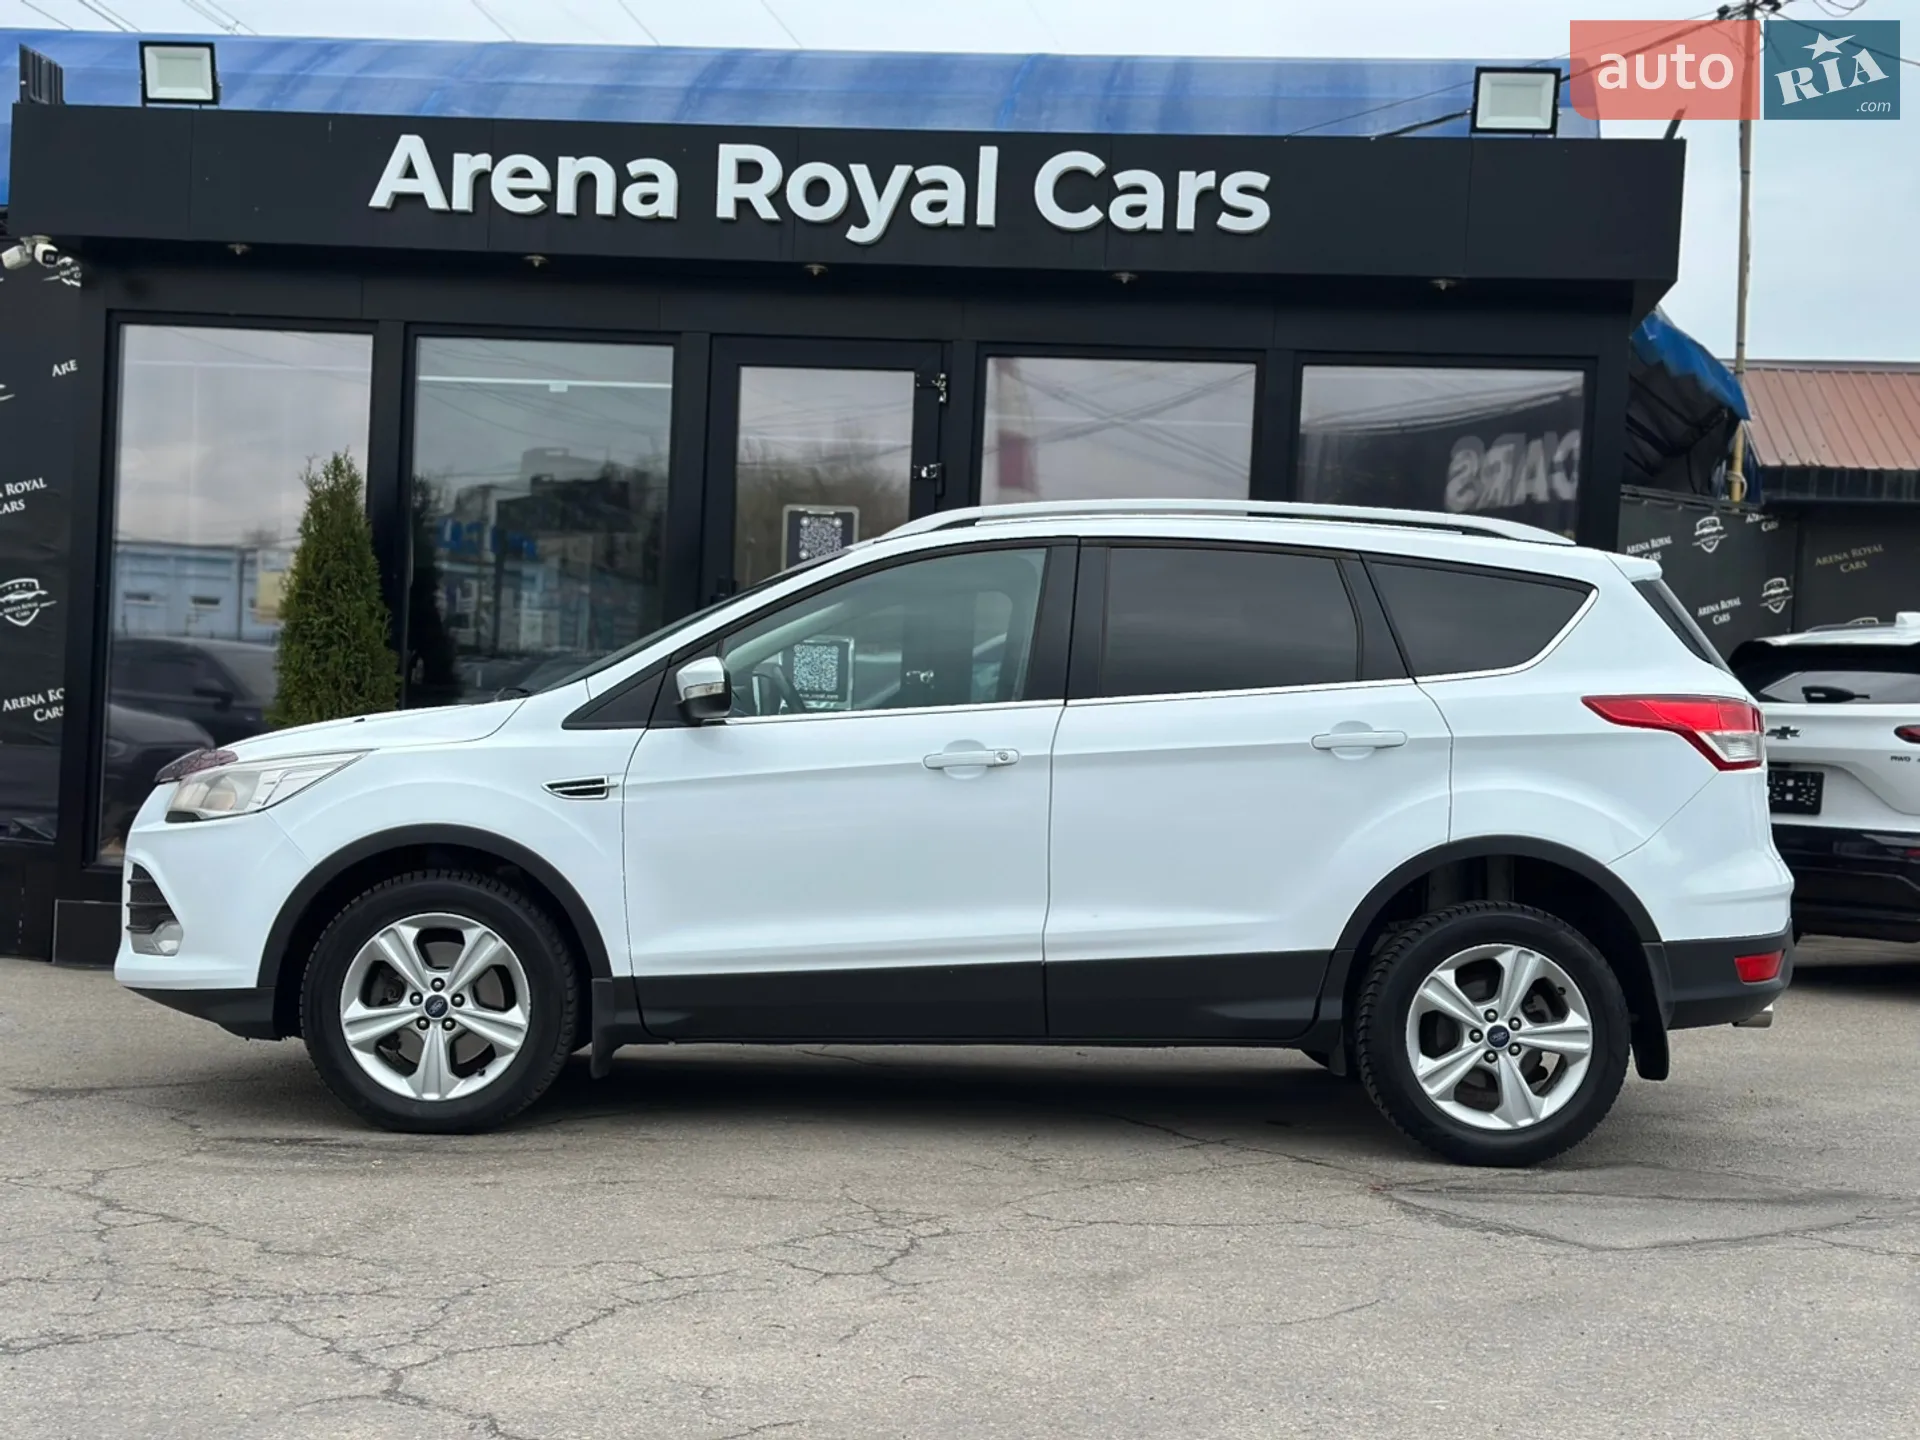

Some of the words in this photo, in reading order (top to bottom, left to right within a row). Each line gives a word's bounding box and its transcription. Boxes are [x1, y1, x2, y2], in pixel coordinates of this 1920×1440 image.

[369, 134, 678, 221] Arena
[715, 143, 999, 246] Royal
[1033, 151, 1273, 233] Cars
[4, 477, 47, 496] ROYAL
[0, 499, 26, 514] ARS
[2, 693, 46, 712] ARENA
